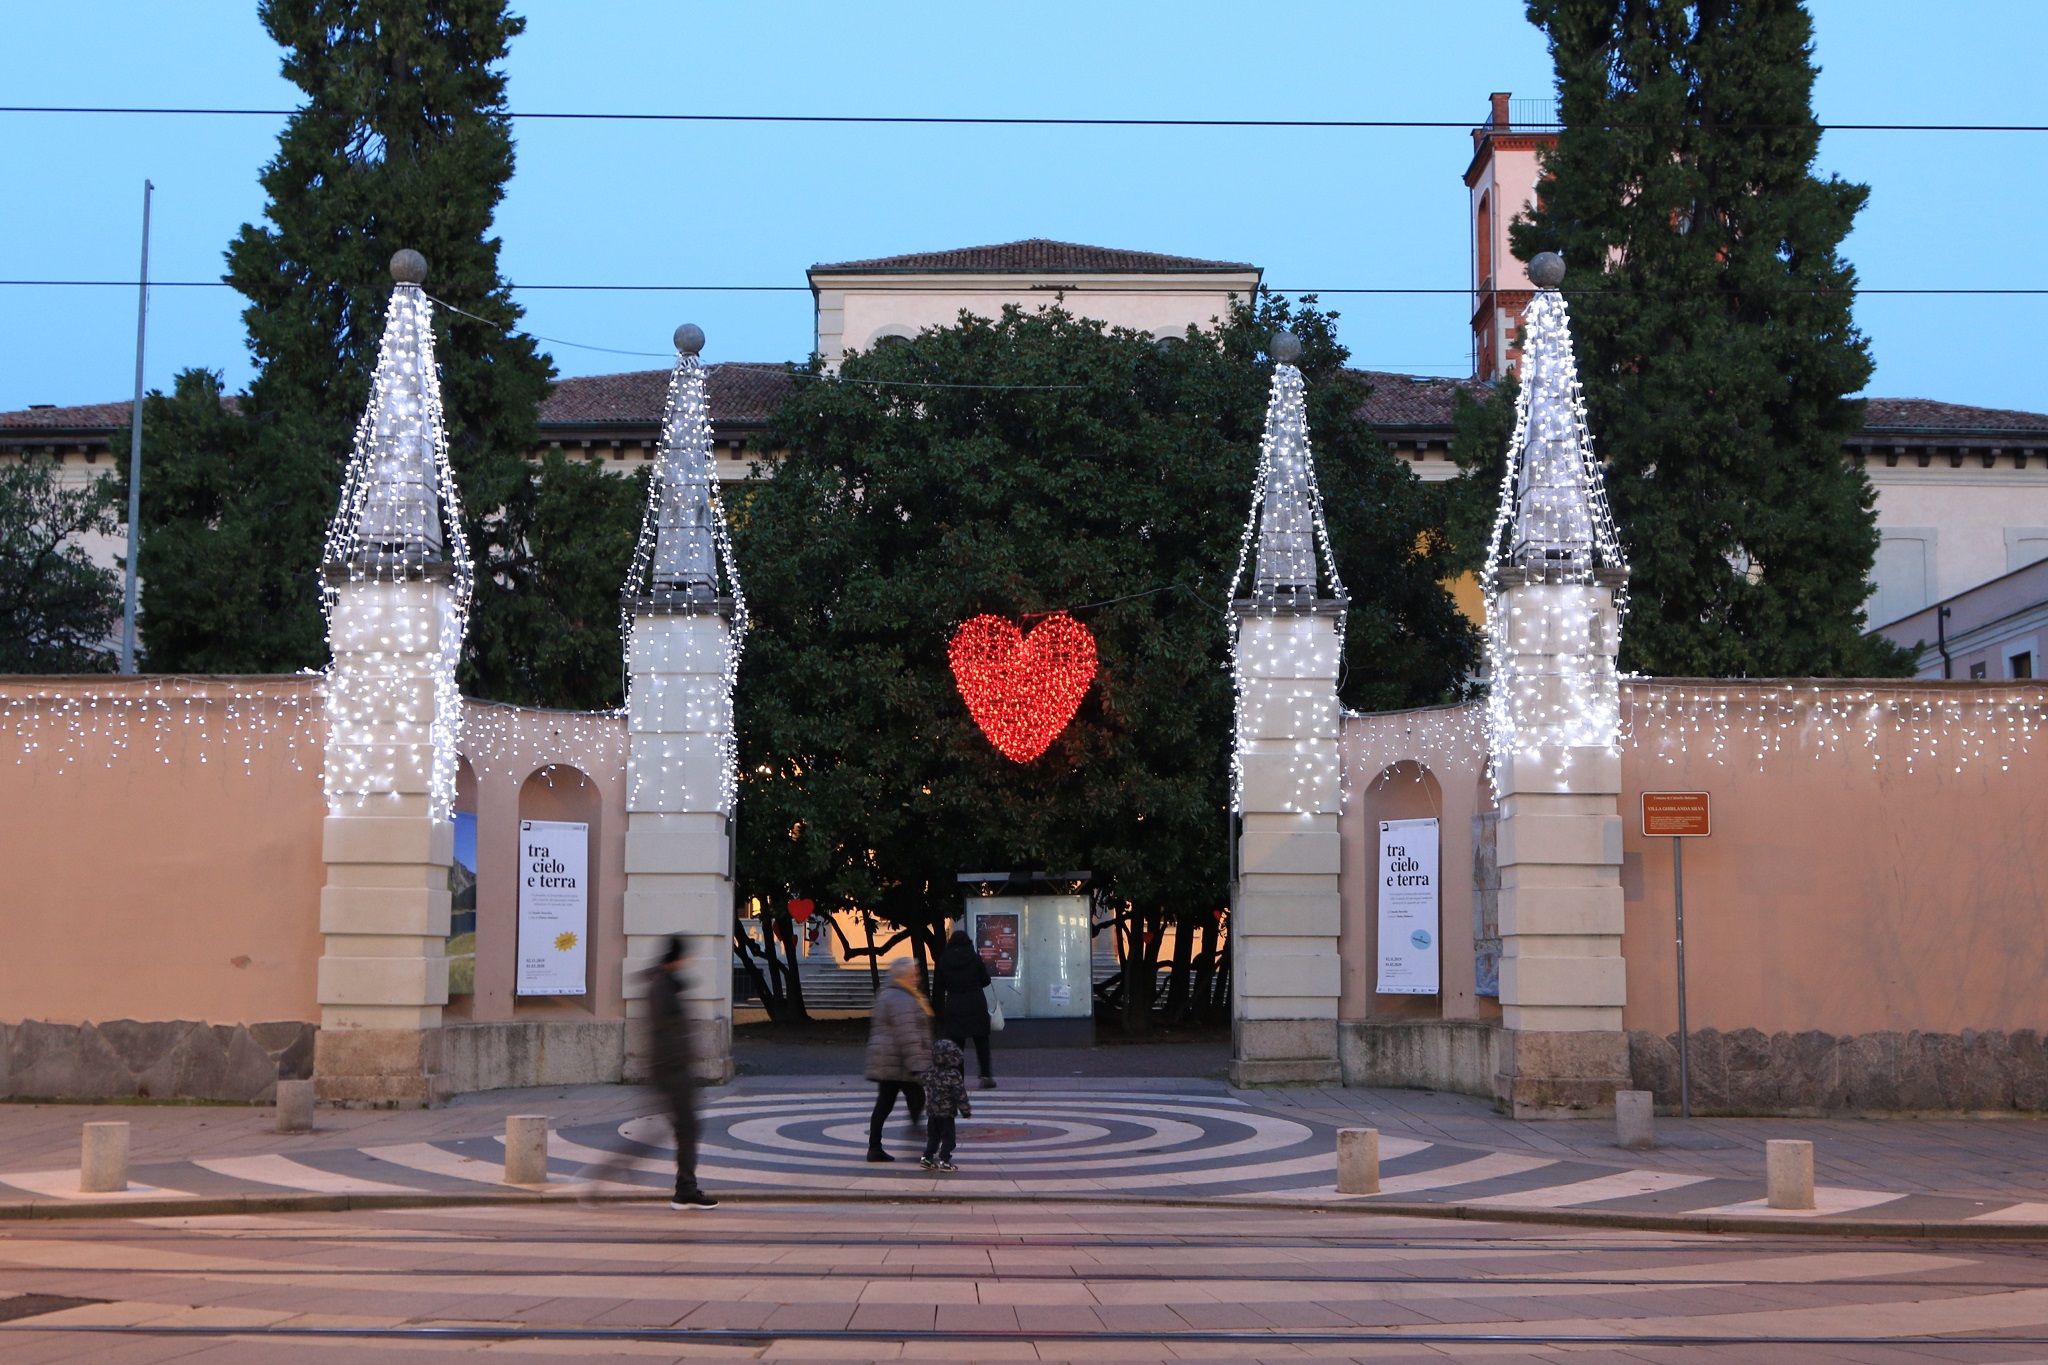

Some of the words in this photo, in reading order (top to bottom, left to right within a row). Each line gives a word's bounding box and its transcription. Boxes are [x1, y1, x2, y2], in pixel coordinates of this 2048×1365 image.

[528, 844, 549, 857] tra
[1387, 844, 1405, 857] tra
[532, 858, 565, 873] cielo
[1390, 857, 1419, 872] cielo
[527, 876, 535, 888] e
[540, 874, 576, 888] terra
[1386, 875, 1394, 887] e
[1397, 873, 1429, 887] terra
